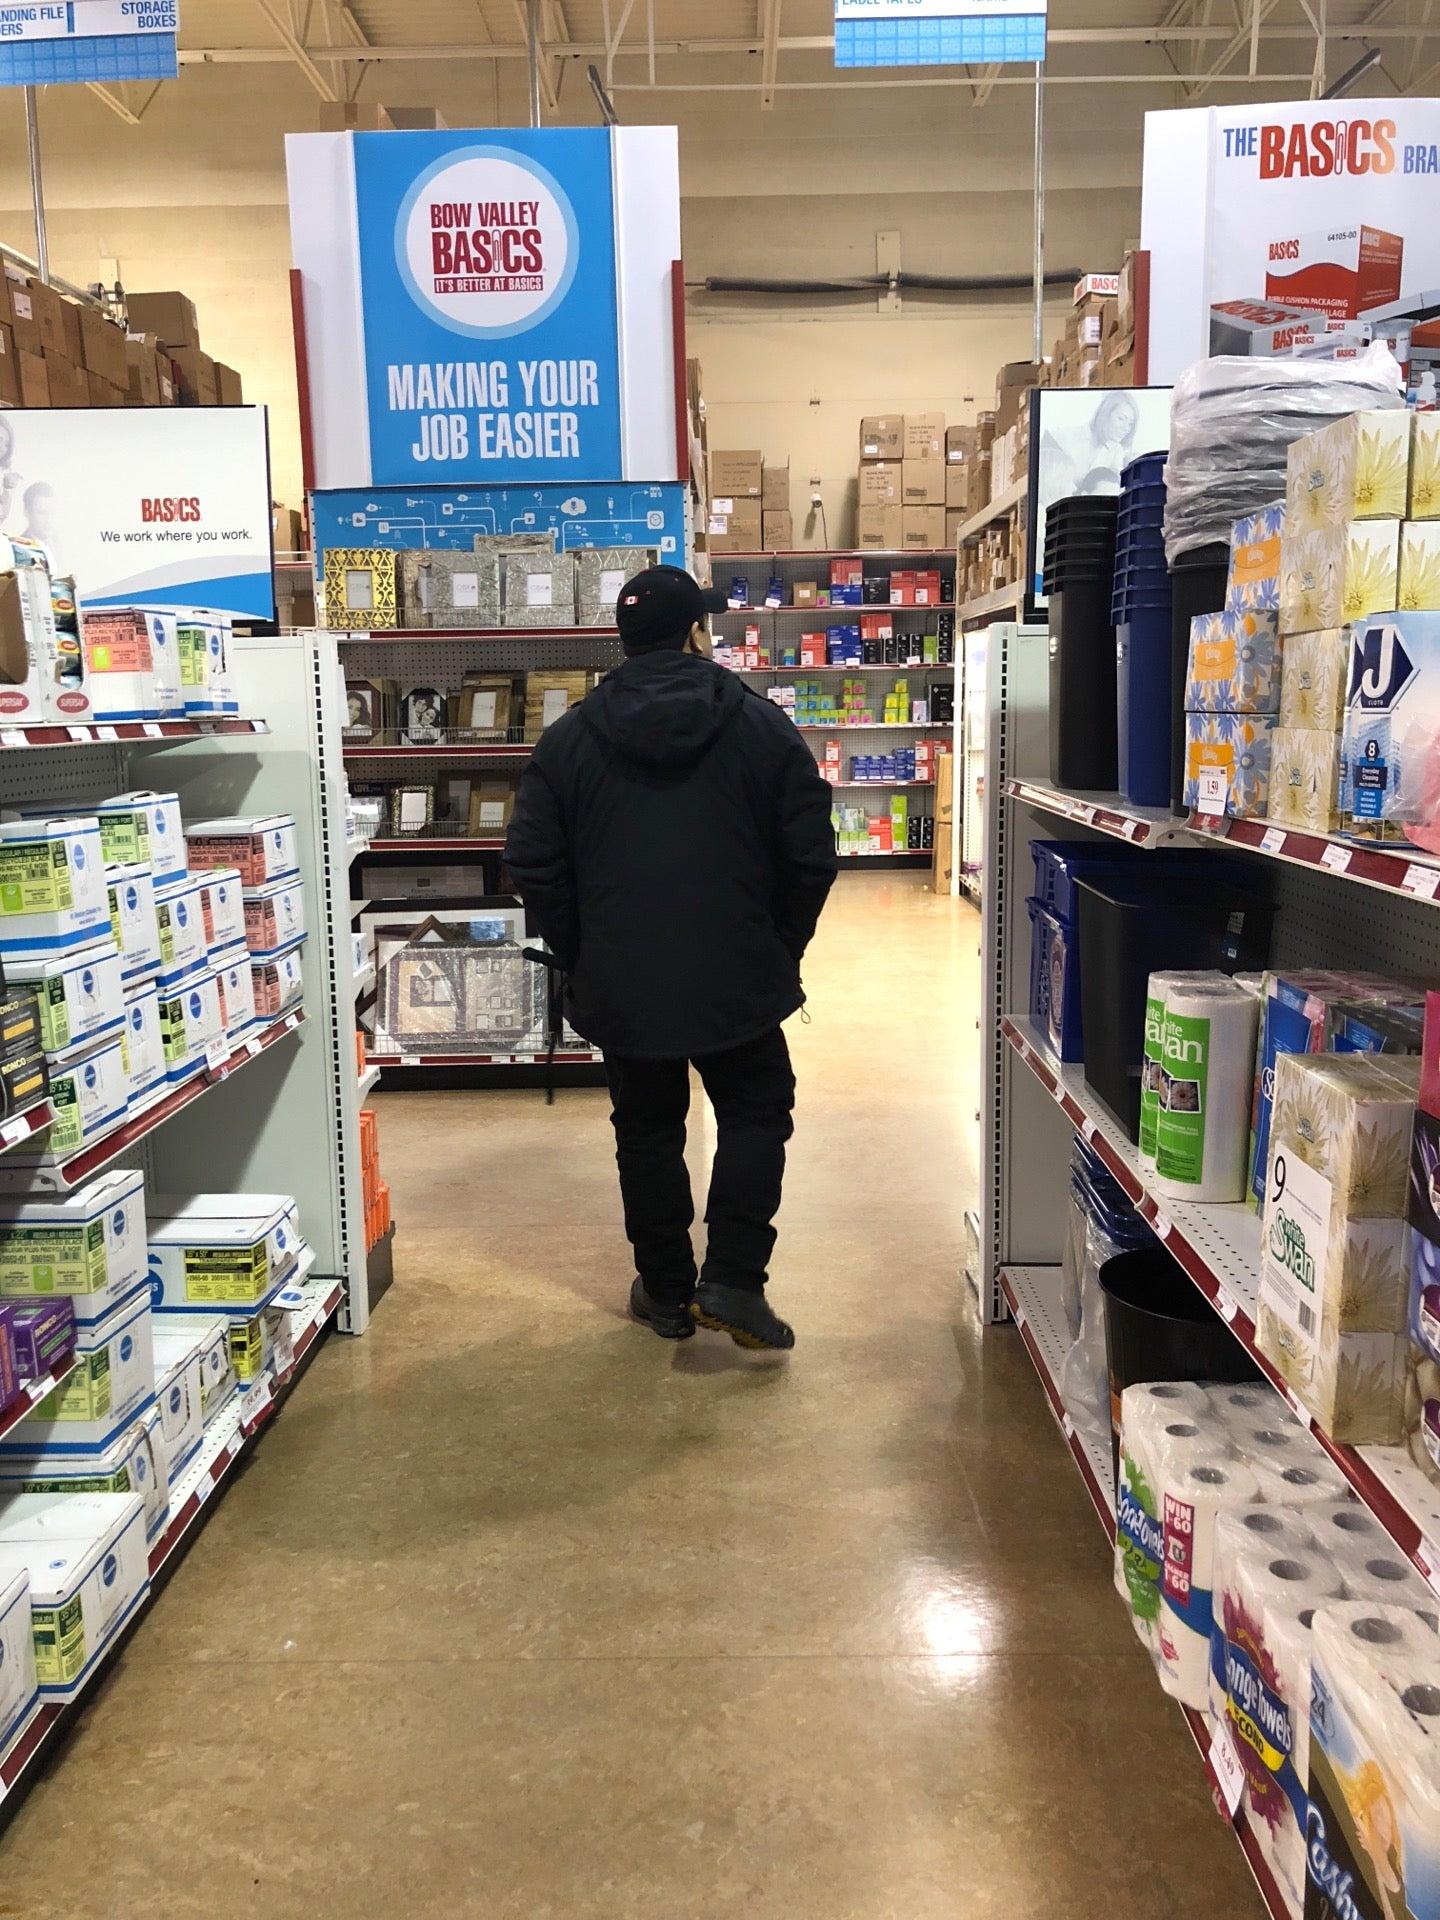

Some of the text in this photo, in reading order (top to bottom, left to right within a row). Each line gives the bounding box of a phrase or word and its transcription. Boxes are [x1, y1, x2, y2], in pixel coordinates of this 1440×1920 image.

[0, 6, 65, 22] NDING FILE
[121, 0, 177, 15] STORAGE
[0, 23, 24, 36] ERS
[137, 14, 177, 29] BOXES
[1223, 126, 1258, 158] THE
[1259, 118, 1397, 180] BASICS
[430, 201, 540, 229] BOW VALLEY
[431, 228, 544, 275] BASICS
[1268, 238, 1301, 262] BASICS
[435, 276, 543, 293] IT'S BETTER AT BASICS
[1285, 296, 1310, 306] CUSHION
[1310, 297, 1349, 309] PACKAGING
[387, 359, 600, 411] MAKING YOUR
[412, 411, 580, 462] JOB EASIER
[141, 496, 202, 523] BASICS
[100, 528, 253, 544] We work where you work.
[1361, 624, 1397, 699] J
[1368, 742, 1376, 757] 8
[1272, 1155, 1287, 1203] 9
[1284, 1213, 1306, 1250] white
[1268, 1206, 1315, 1294] Swan
[1165, 1496, 1192, 1522] WIN
